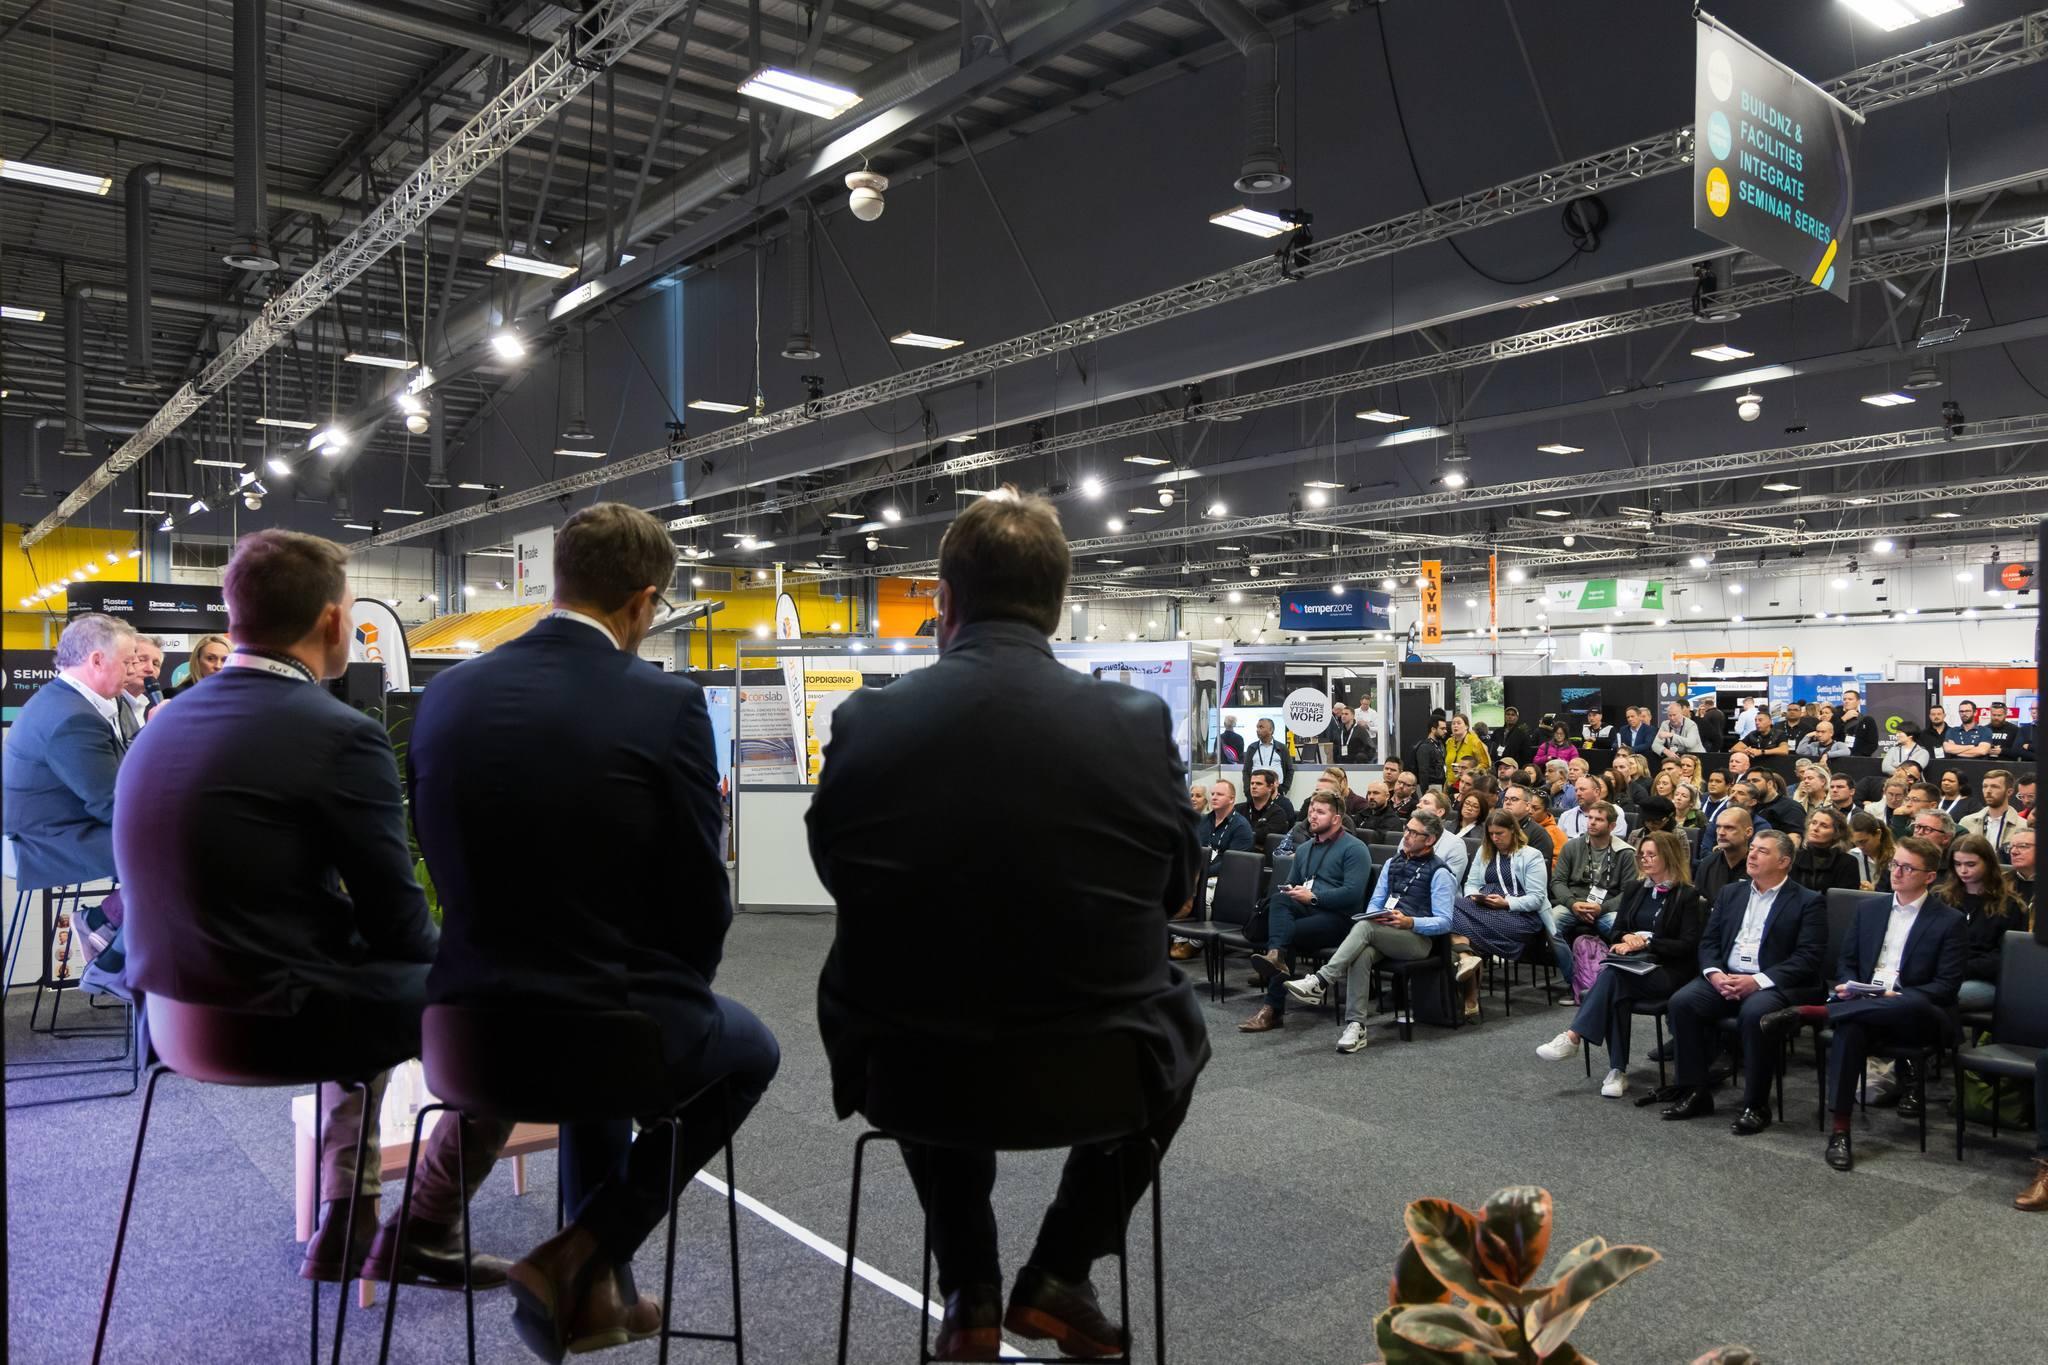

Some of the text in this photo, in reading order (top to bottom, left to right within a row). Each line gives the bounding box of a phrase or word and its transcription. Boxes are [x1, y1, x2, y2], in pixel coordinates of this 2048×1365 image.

[1741, 91, 1791, 137] BUILDNZ
[1794, 124, 1803, 145] &
[1740, 120, 1803, 172] FACILITIES
[1739, 150, 1804, 202] INTEGRATE
[1739, 181, 1791, 224] SEMINAR
[1794, 209, 1831, 244] SERIES
[525, 545, 538, 560] made
[525, 584, 547, 597] Germany
[1304, 603, 1353, 616] temperzone
[14, 669, 58, 679] SEMIN
[748, 691, 783, 702] conslab
